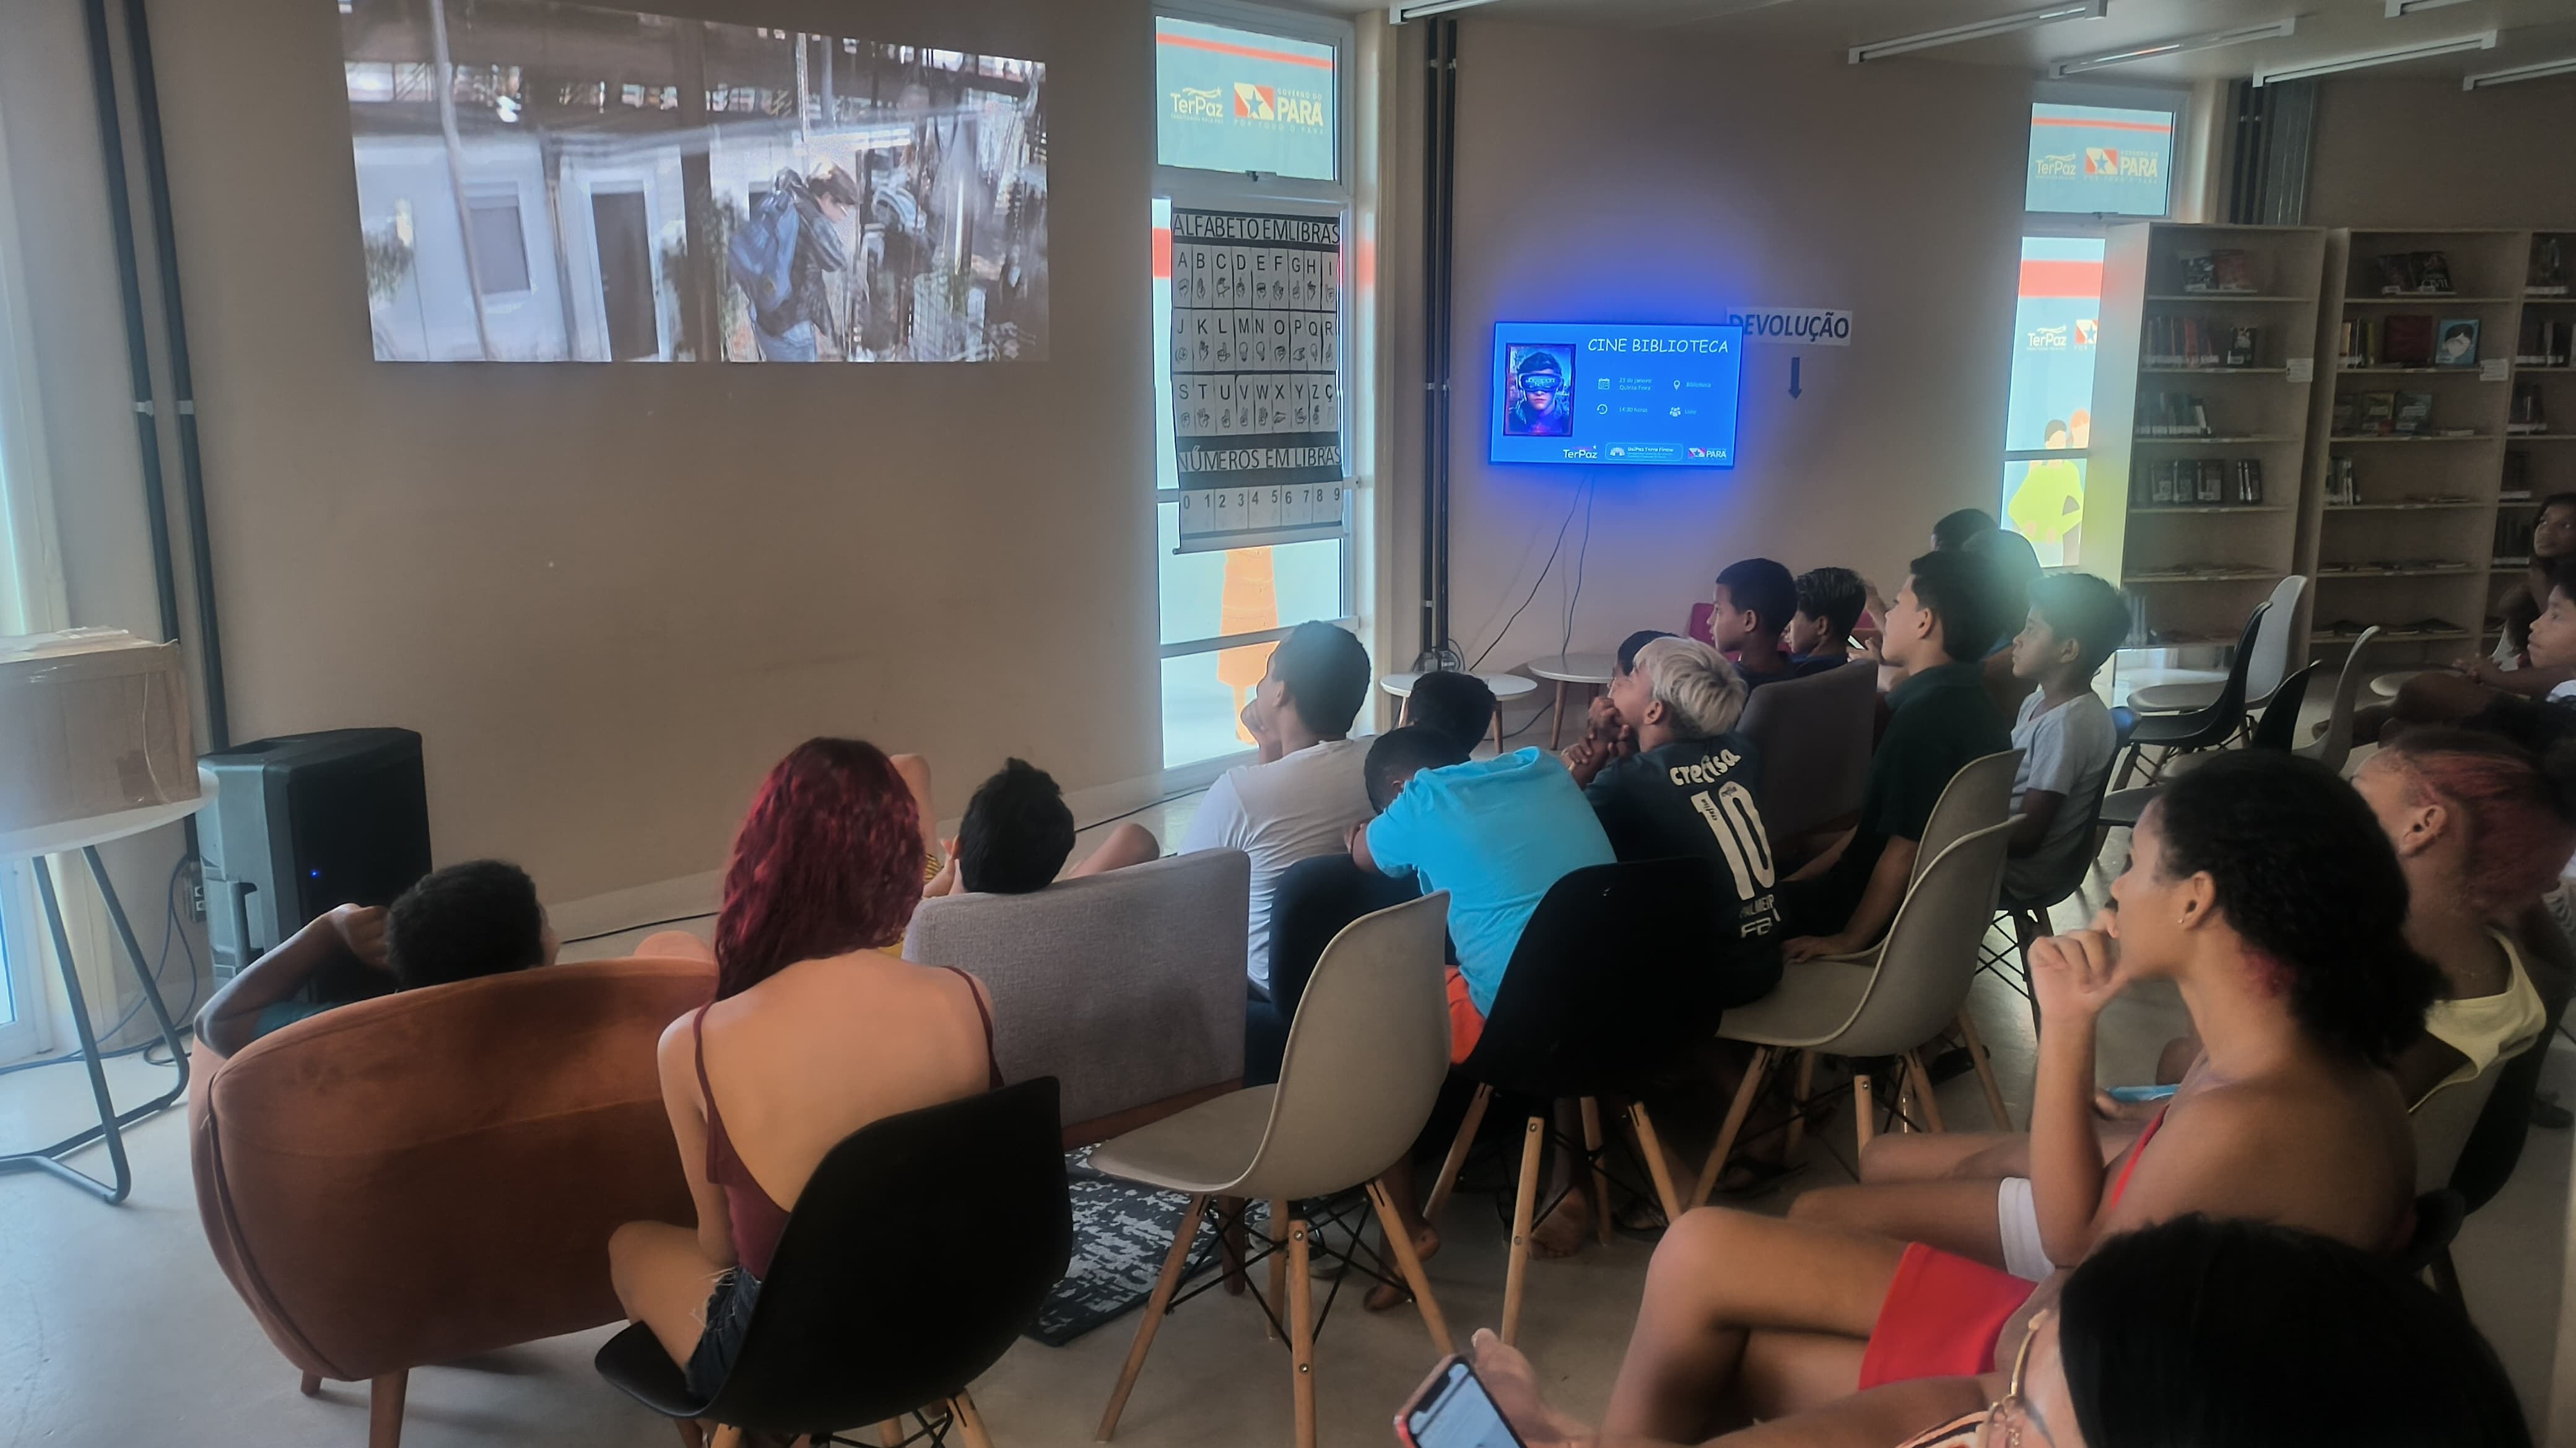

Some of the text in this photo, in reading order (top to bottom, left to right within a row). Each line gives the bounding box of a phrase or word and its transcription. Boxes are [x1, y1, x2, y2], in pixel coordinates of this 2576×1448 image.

[1170, 92, 1224, 118] TerPaz
[2035, 159, 2076, 175] TerPaz
[1173, 214, 1259, 239] ALFABETO
[1178, 252, 1188, 268] A
[1196, 253, 1205, 268] B
[1216, 253, 1227, 269] C
[1238, 255, 1246, 270] D
[1257, 255, 1265, 271] E
[1275, 256, 1282, 271] F
[1292, 258, 1300, 273] G
[1307, 259, 1316, 274] H
[1178, 318, 1334, 336] J K L M N O P Q R
[1588, 338, 1728, 353] CINE BIBLIOTECA
[2027, 332, 2066, 346] TerPaz
[1179, 384, 1333, 403] S T U V W X Y Z Ç
[1179, 445, 1341, 471] NÚMEROS EM LIBRAS
[1562, 449, 1598, 458] TerPaz
[1183, 487, 1340, 509] 0 1 2 3 4 5 6 7 8 9
[1669, 749, 1741, 786] crefisa
[1690, 780, 1775, 901] 10
